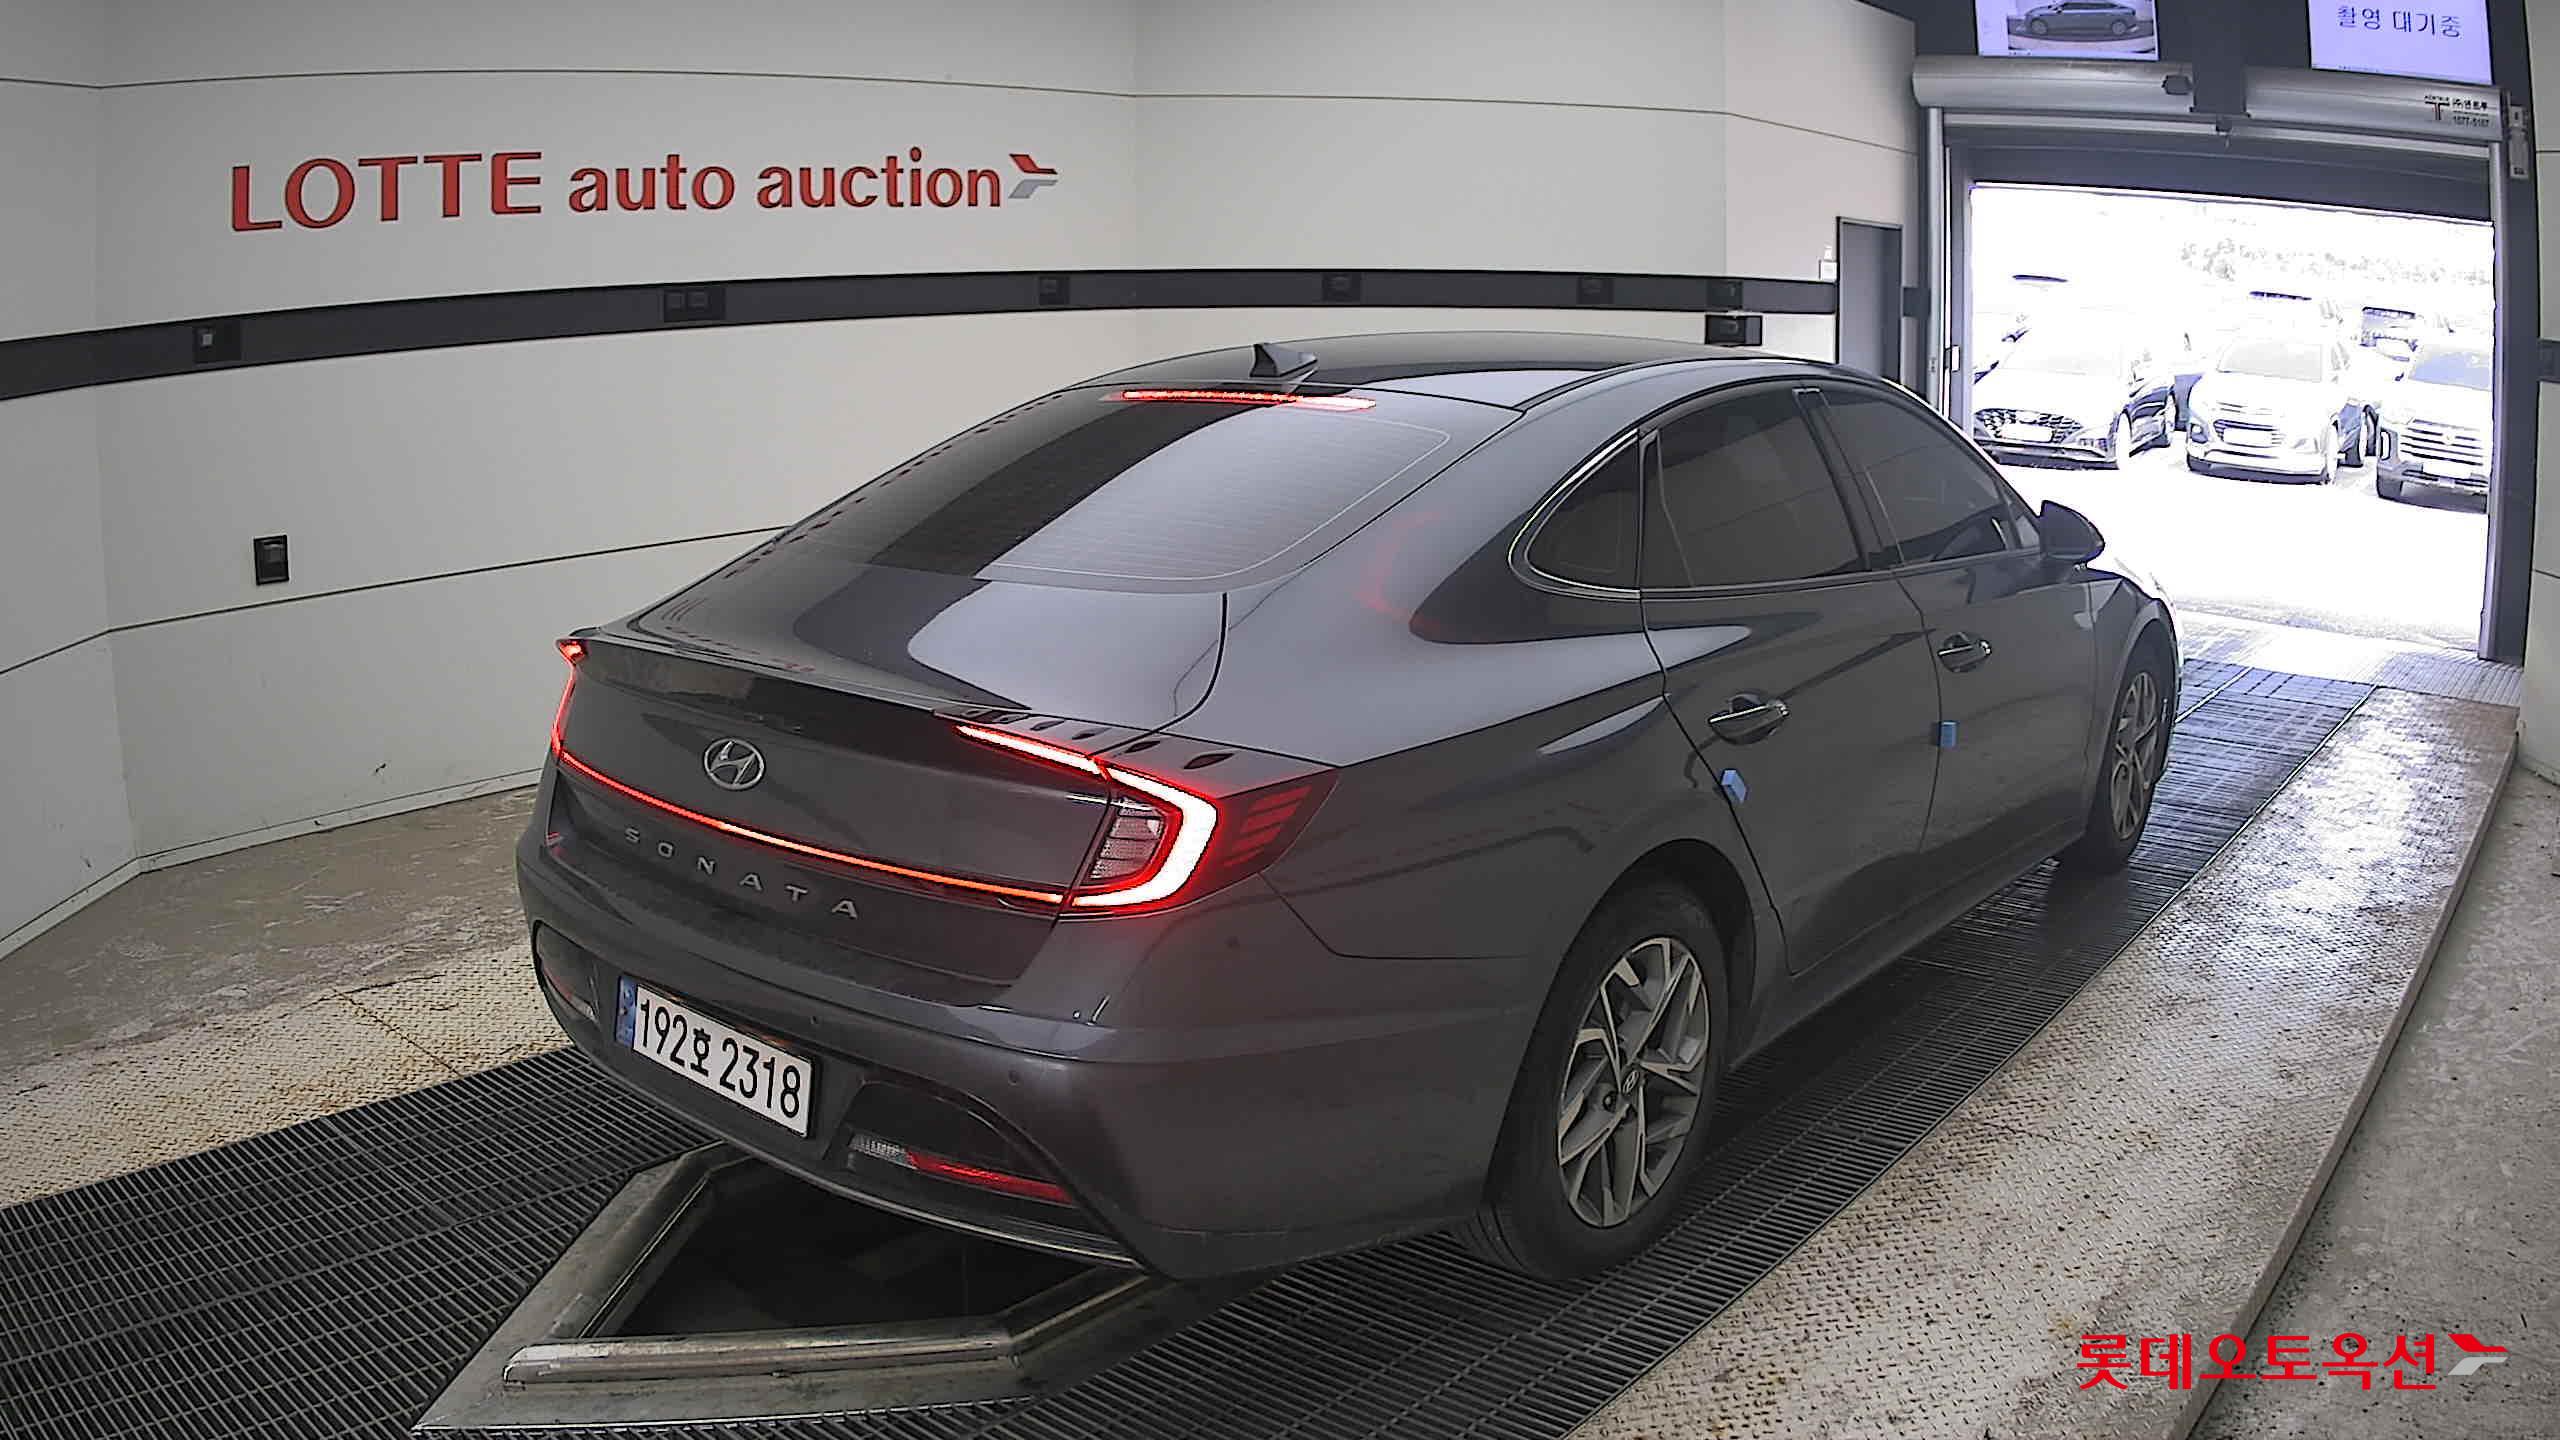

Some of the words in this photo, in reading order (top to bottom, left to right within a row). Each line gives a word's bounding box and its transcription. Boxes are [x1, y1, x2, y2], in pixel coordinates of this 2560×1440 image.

[2393, 11, 2461, 38] 대기중
[231, 151, 542, 233] LOTTE
[568, 152, 736, 212] auto
[756, 146, 1001, 210] auction
[624, 826, 859, 920] SONATA
[640, 998, 712, 1077] 192호
[719, 1036, 801, 1118] 2318
